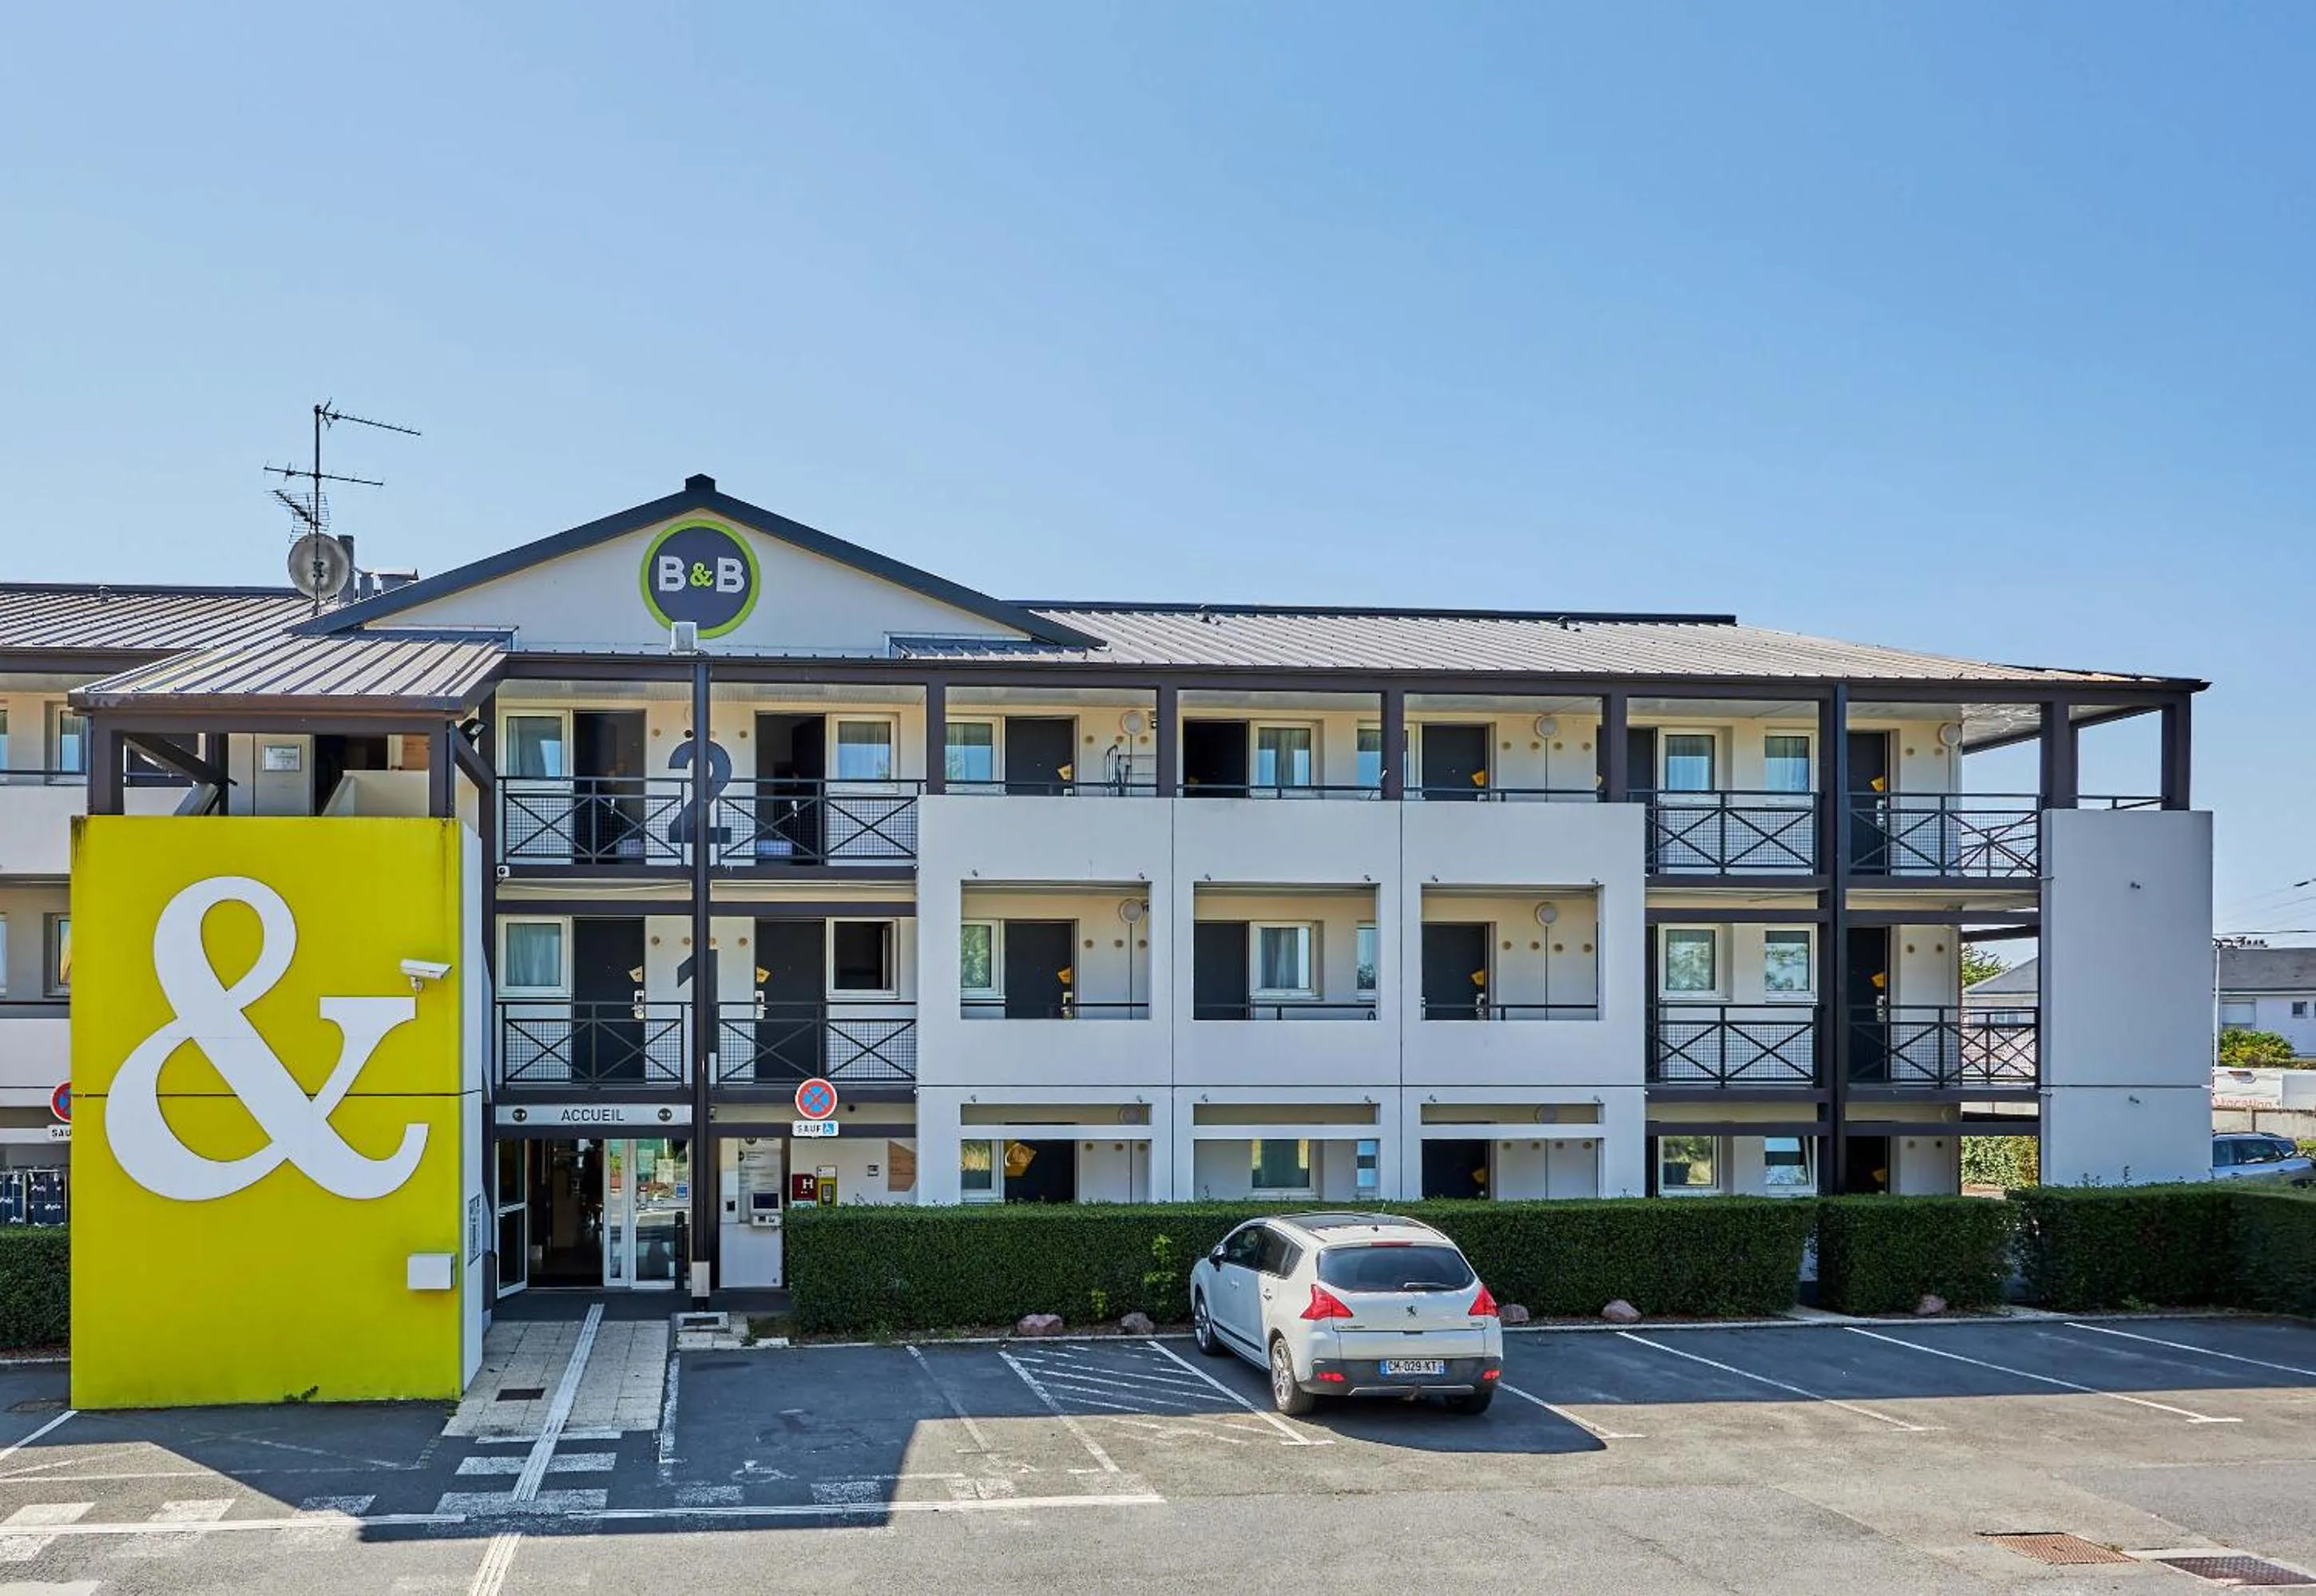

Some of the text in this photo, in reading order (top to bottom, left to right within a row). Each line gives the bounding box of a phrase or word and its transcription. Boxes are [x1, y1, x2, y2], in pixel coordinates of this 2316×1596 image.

[659, 556, 745, 593] B&B
[668, 740, 732, 843] 2
[105, 875, 429, 1202] &
[561, 1108, 625, 1122] ACCUEIL
[798, 1124, 823, 1134] SAUF
[802, 1178, 814, 1190] H
